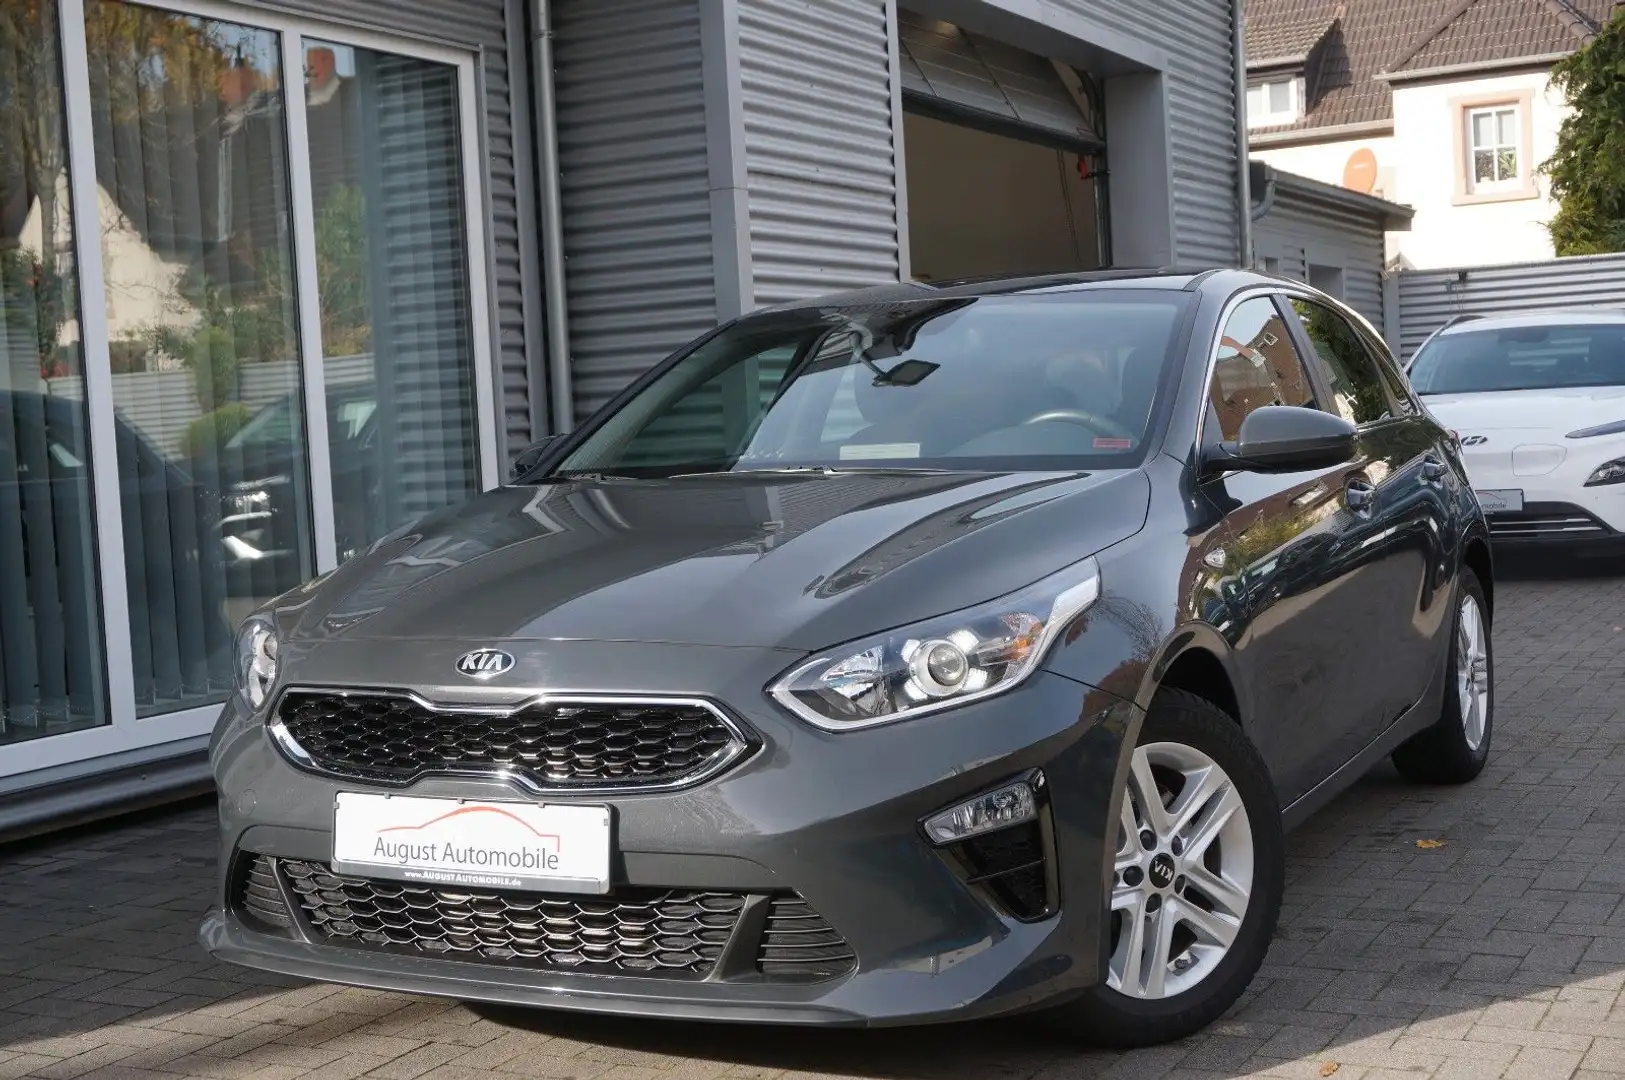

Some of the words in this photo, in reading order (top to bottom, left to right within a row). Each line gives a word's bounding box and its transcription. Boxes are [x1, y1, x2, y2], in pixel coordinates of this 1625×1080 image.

[461, 653, 503, 671] KIA
[374, 836, 437, 864] August
[442, 842, 560, 870] Automobile
